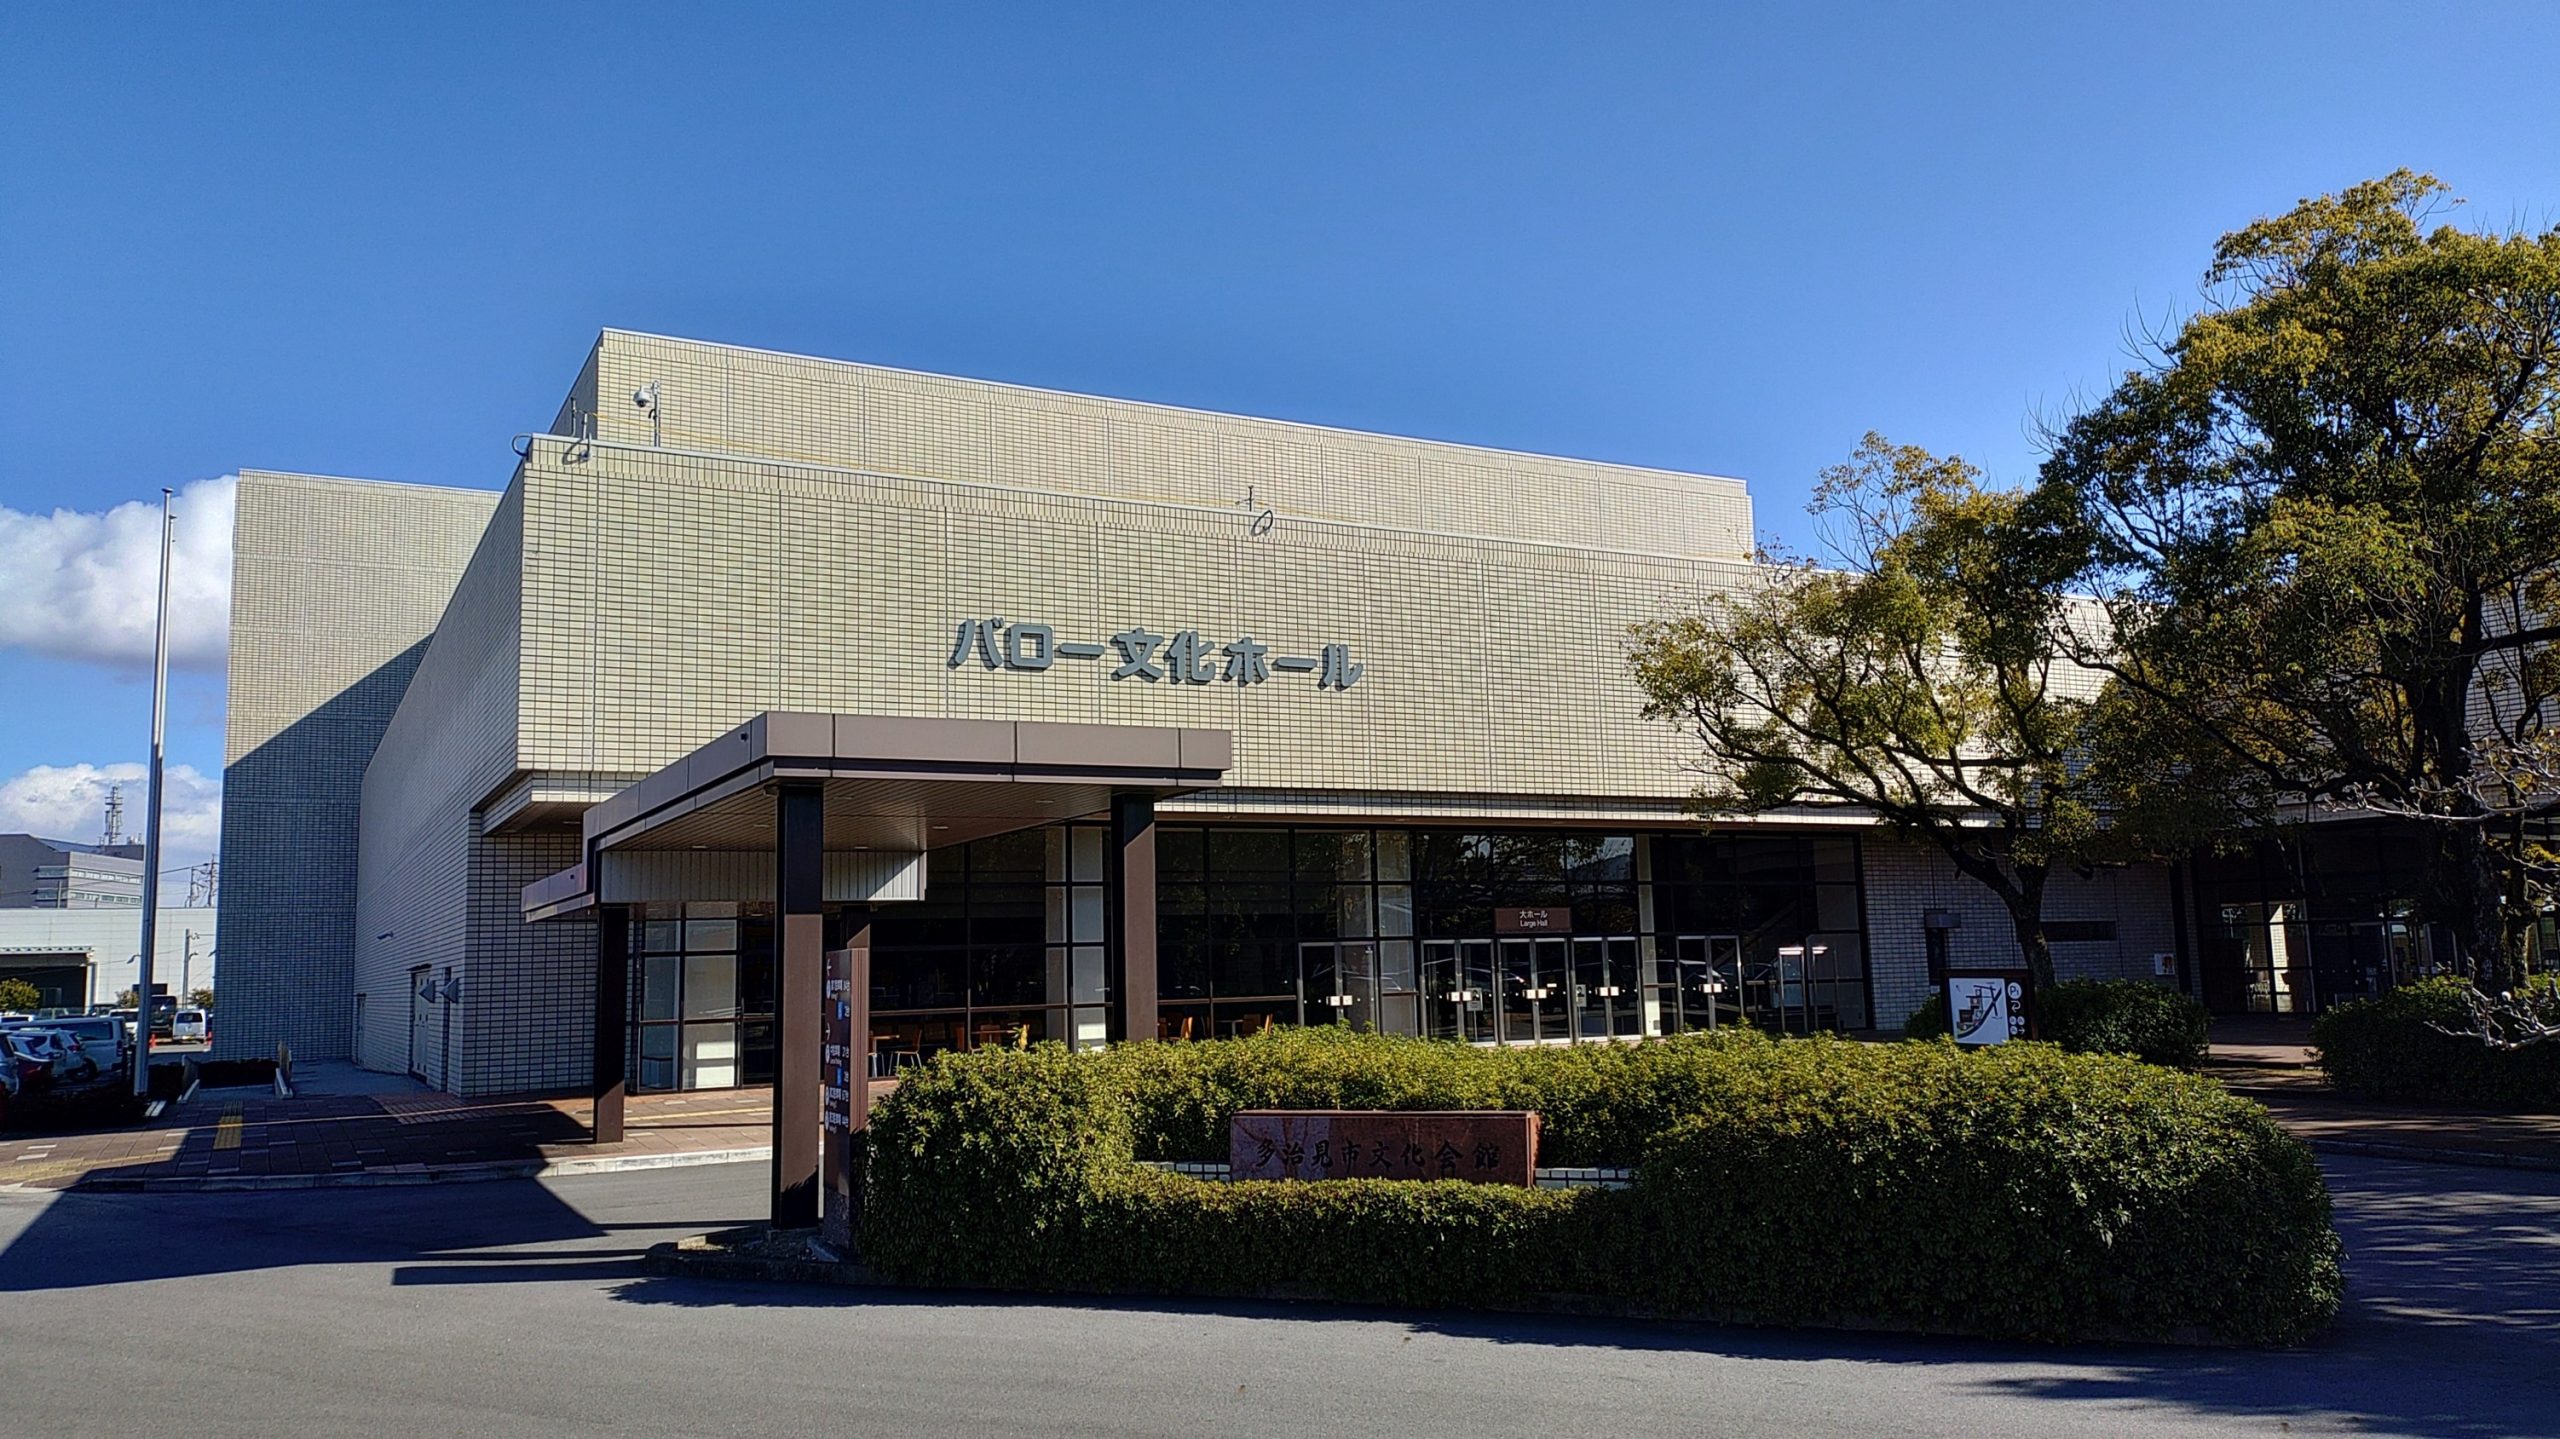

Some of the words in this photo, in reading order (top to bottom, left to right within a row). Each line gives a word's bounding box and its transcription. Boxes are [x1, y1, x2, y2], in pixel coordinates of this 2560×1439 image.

[948, 617, 1363, 690] バロー文化ホール
[1519, 910, 1548, 919] 大ホール
[1520, 919, 1536, 928] Large
[1537, 919, 1548, 927] Hall
[1256, 1139, 1501, 1171] 多治見市文化会館
